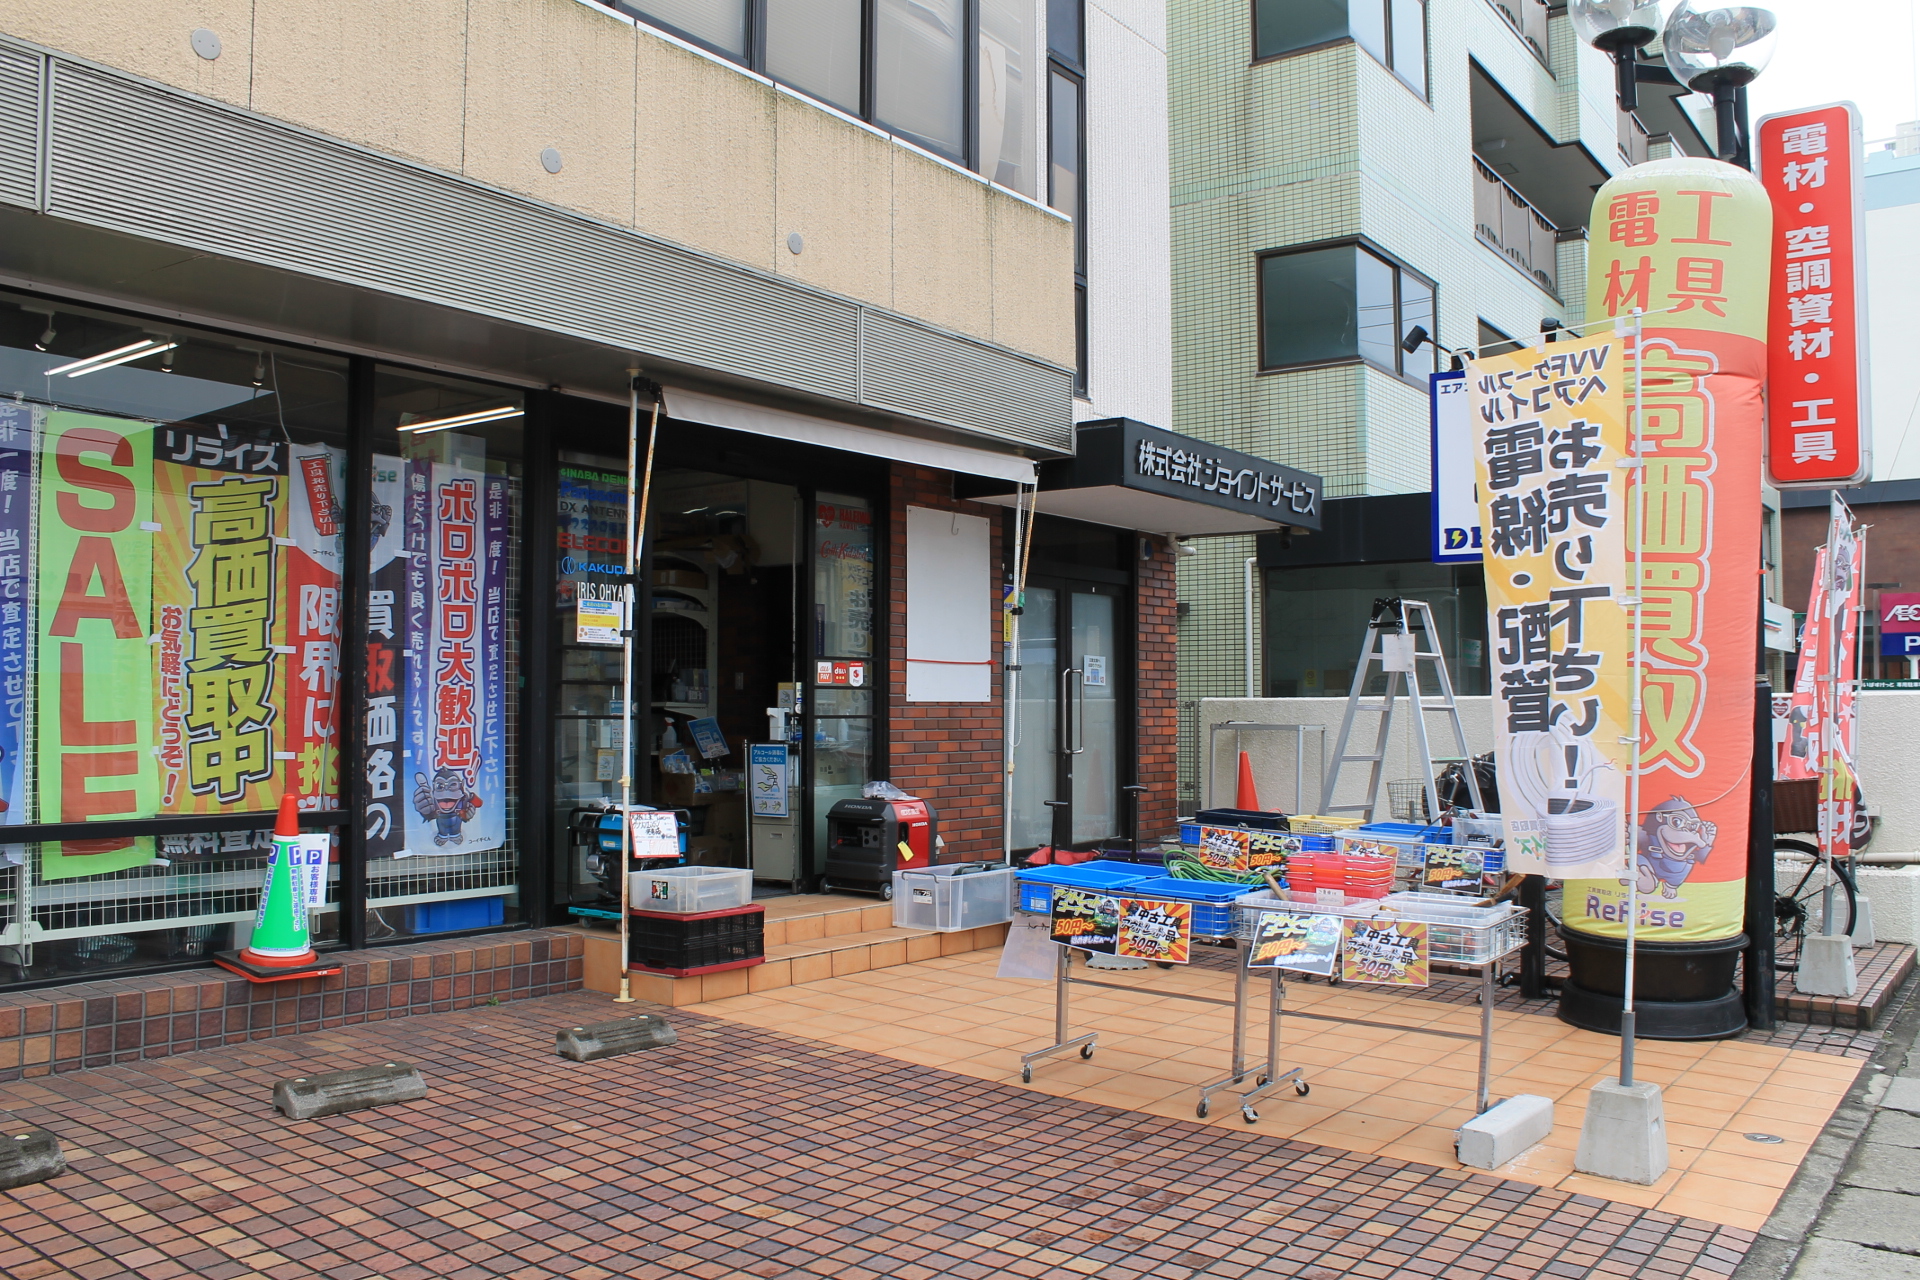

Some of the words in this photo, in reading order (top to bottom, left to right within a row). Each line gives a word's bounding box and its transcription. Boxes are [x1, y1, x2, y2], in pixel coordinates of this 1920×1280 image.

[1602, 189, 1660, 317] 電材
[1666, 189, 1733, 318] 工具
[1782, 122, 1837, 464] 電材・空調資材・工具
[165, 424, 282, 473] リライズ
[560, 481, 628, 504] Panasoni
[601, 472, 639, 487] DEN
[560, 501, 577, 512] DX
[582, 504, 630, 519] ANTENN
[558, 532, 628, 556] ELECO
[577, 581, 596, 600] IRIS
[48, 427, 143, 857] SALE
[187, 476, 277, 798] 高価買取中
[159, 605, 185, 805] お気軽にどうぞ!
[298, 584, 341, 812] 限界に挑
[310, 851, 321, 864] P
[308, 866, 320, 904] お客様専用
[1366, 930, 1420, 950] 中古工具
